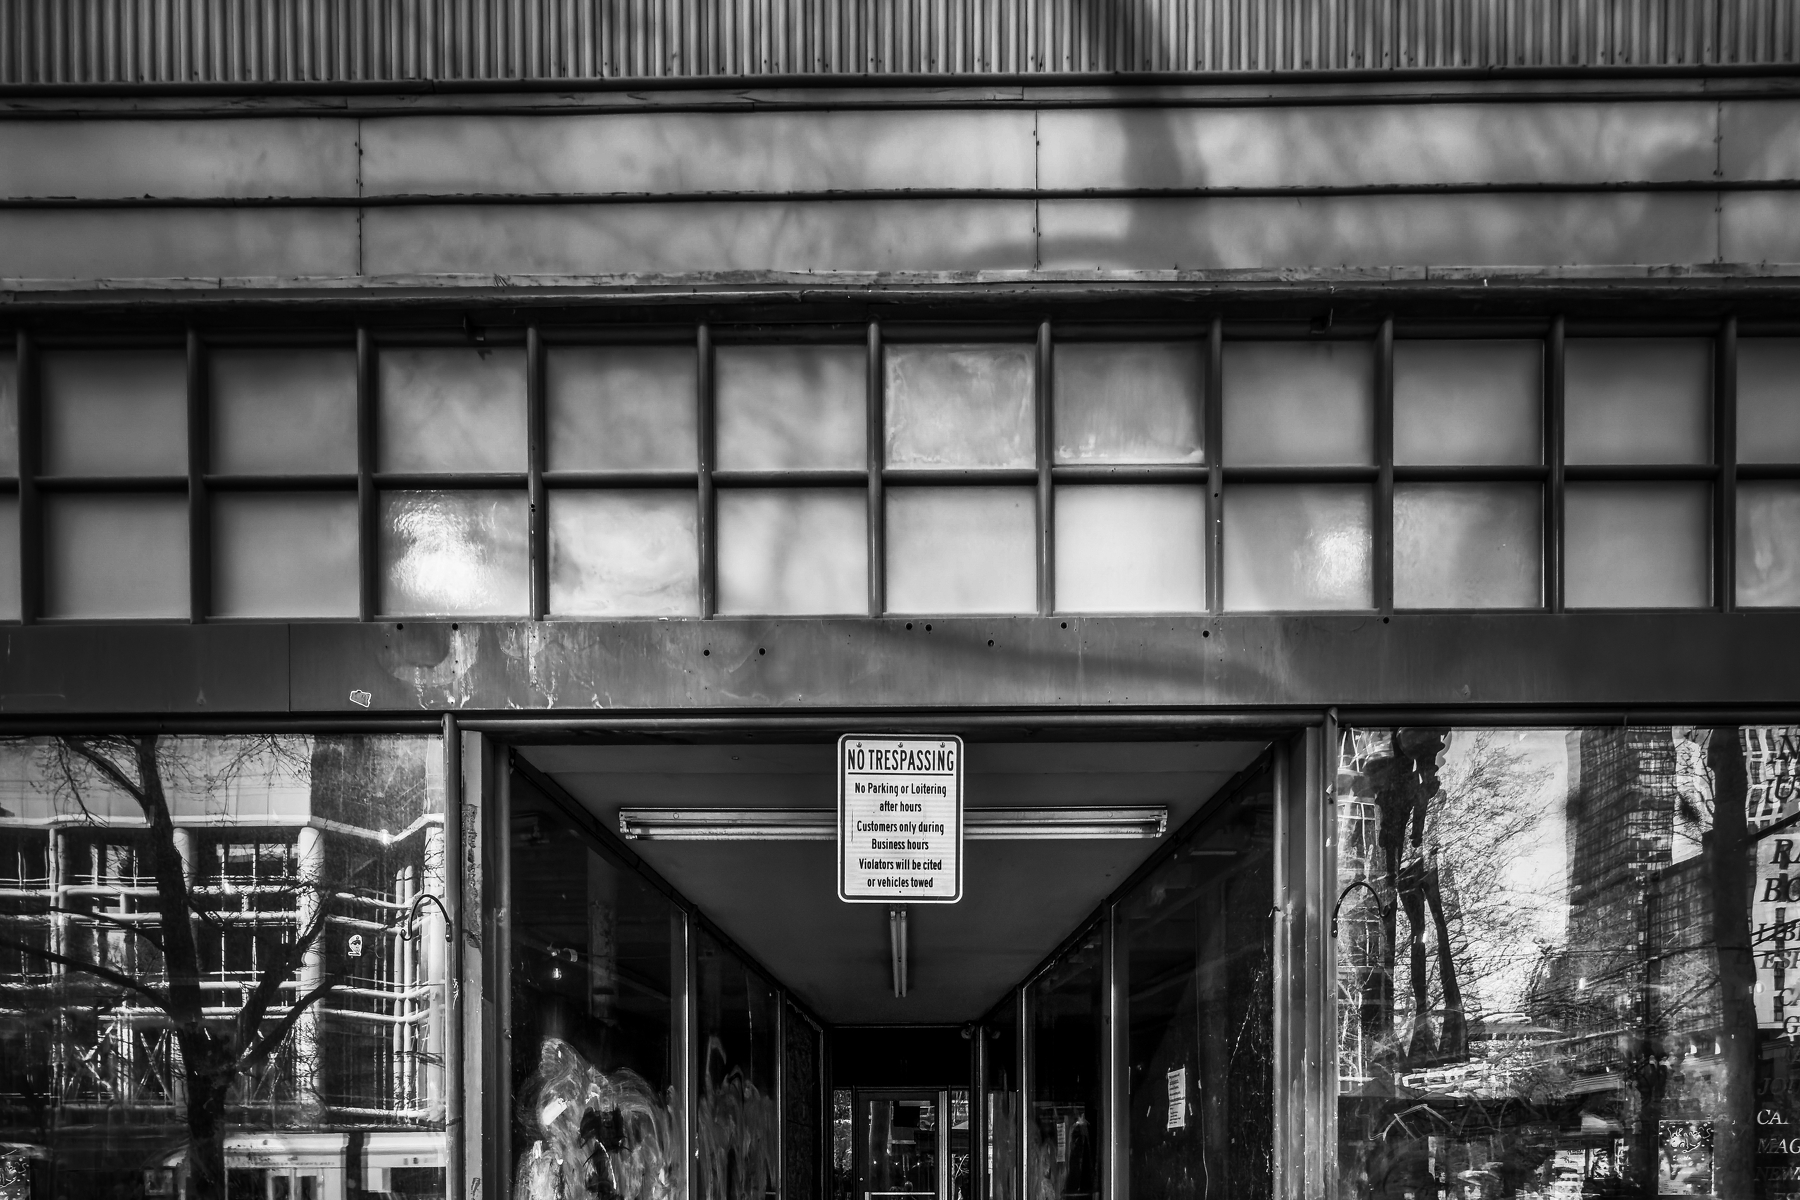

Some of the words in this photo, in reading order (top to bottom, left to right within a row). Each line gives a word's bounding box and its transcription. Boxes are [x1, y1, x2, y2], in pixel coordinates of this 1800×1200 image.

[848, 749, 865, 771] NO
[868, 749, 954, 772] TRESPASSING
[855, 782, 866, 794] No
[867, 783, 899, 797] Parking
[900, 786, 910, 794] or
[911, 783, 947, 798] Loitering
[879, 801, 898, 812] after
[900, 801, 922, 812] hours
[857, 821, 898, 832] Customers
[899, 821, 917, 835] only
[918, 821, 945, 835] during
[871, 839, 906, 850] Business
[907, 839, 929, 850] hours
[858, 858, 894, 870] Violators
[895, 859, 910, 870] will
[911, 859, 922, 870] be
[922, 859, 942, 871] cited
[867, 879, 876, 888] or
[877, 877, 909, 888] vehicles
[910, 877, 934, 888] towed
